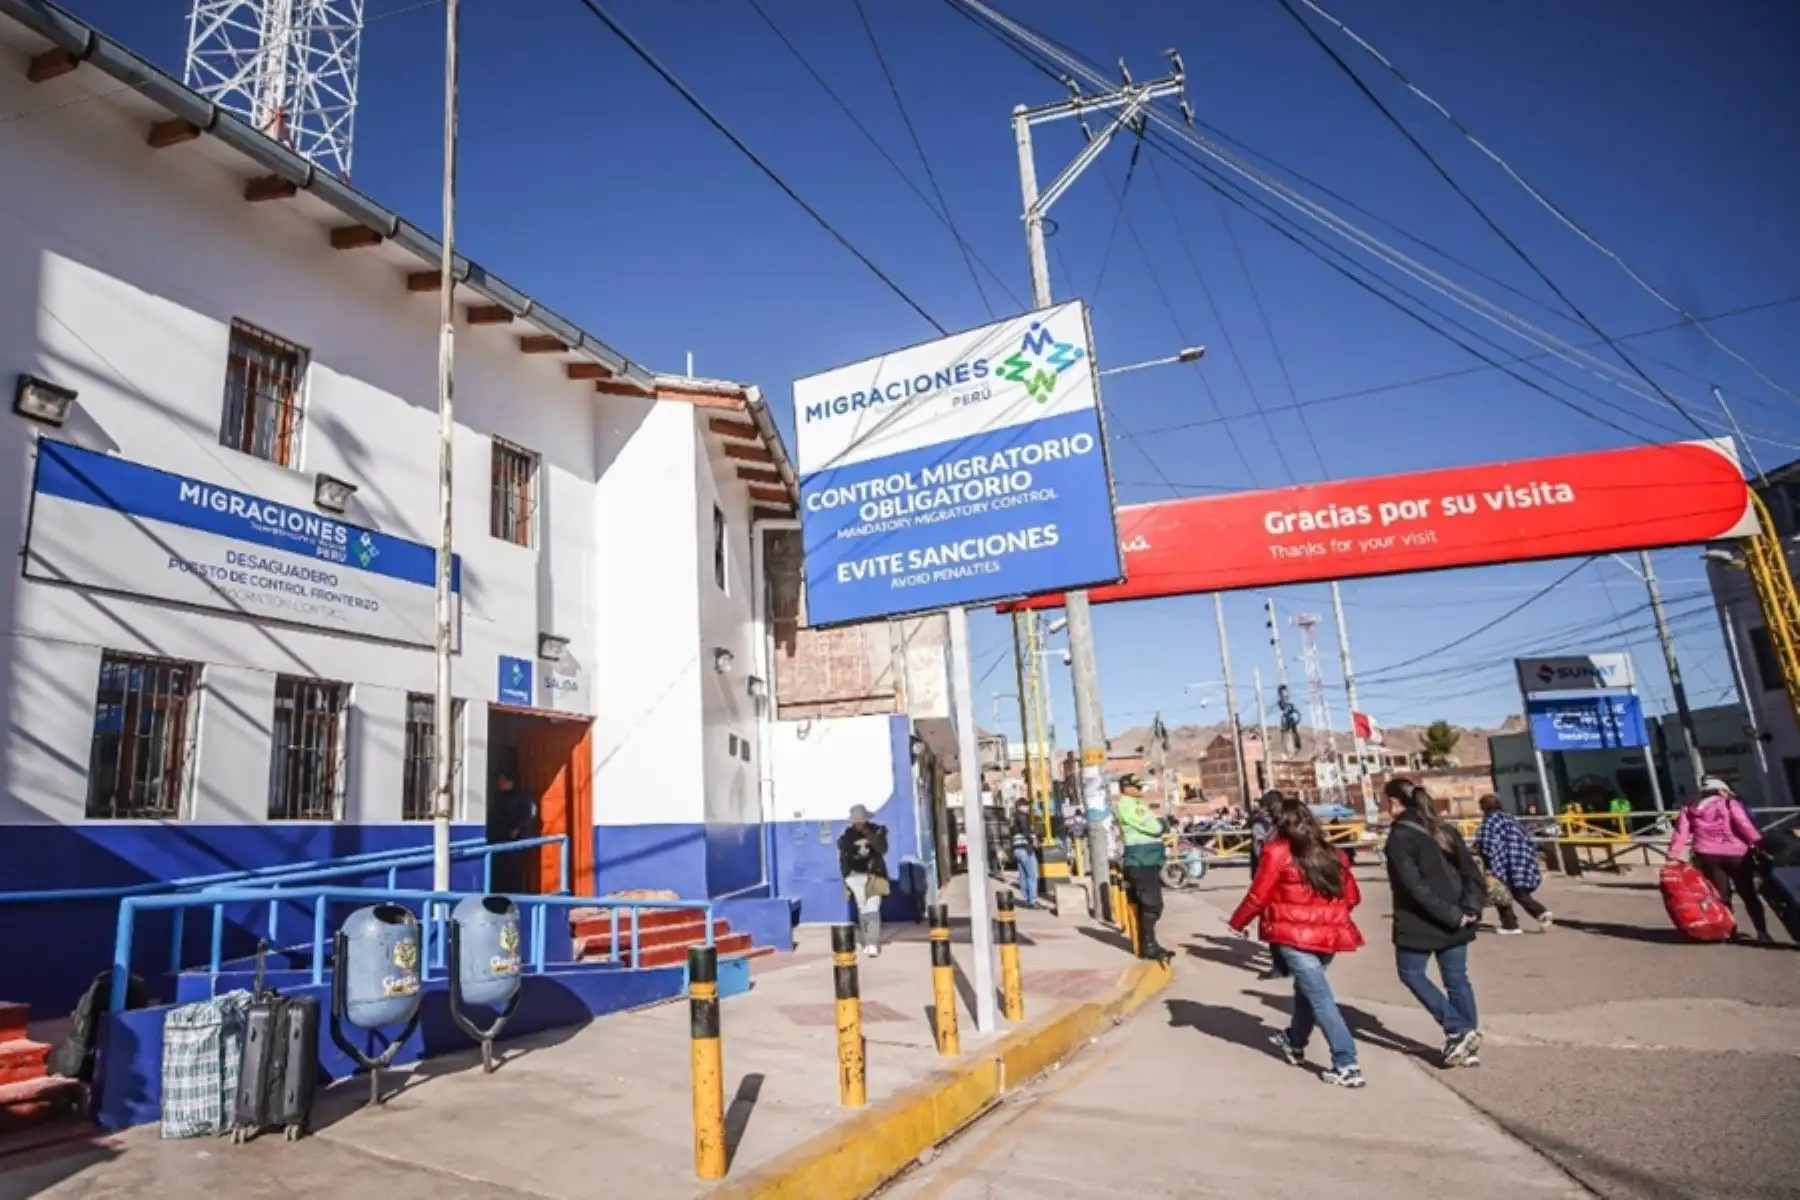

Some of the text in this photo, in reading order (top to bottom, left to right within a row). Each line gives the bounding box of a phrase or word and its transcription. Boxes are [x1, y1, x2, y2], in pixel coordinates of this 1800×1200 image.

[804, 359, 989, 423] MIGRACIONES
[806, 432, 1094, 512] CONTROL MIGRATORIO
[859, 470, 1032, 522] OBLIGATORIO
[179, 481, 348, 544] MIGRACIONES
[837, 487, 1058, 540] MANDATORY MIGRATORY CONTROL
[1264, 481, 1575, 535] Gracias por su visita
[225, 550, 338, 587] DESAGUADERO
[837, 524, 1059, 583] EVITE SANCIONES
[1269, 529, 1439, 560] Thanks for your visit
[168, 557, 380, 612] PUESTO DE CONTROL FRONTERIZO
[890, 560, 1001, 590] AVOID PENALTIES
